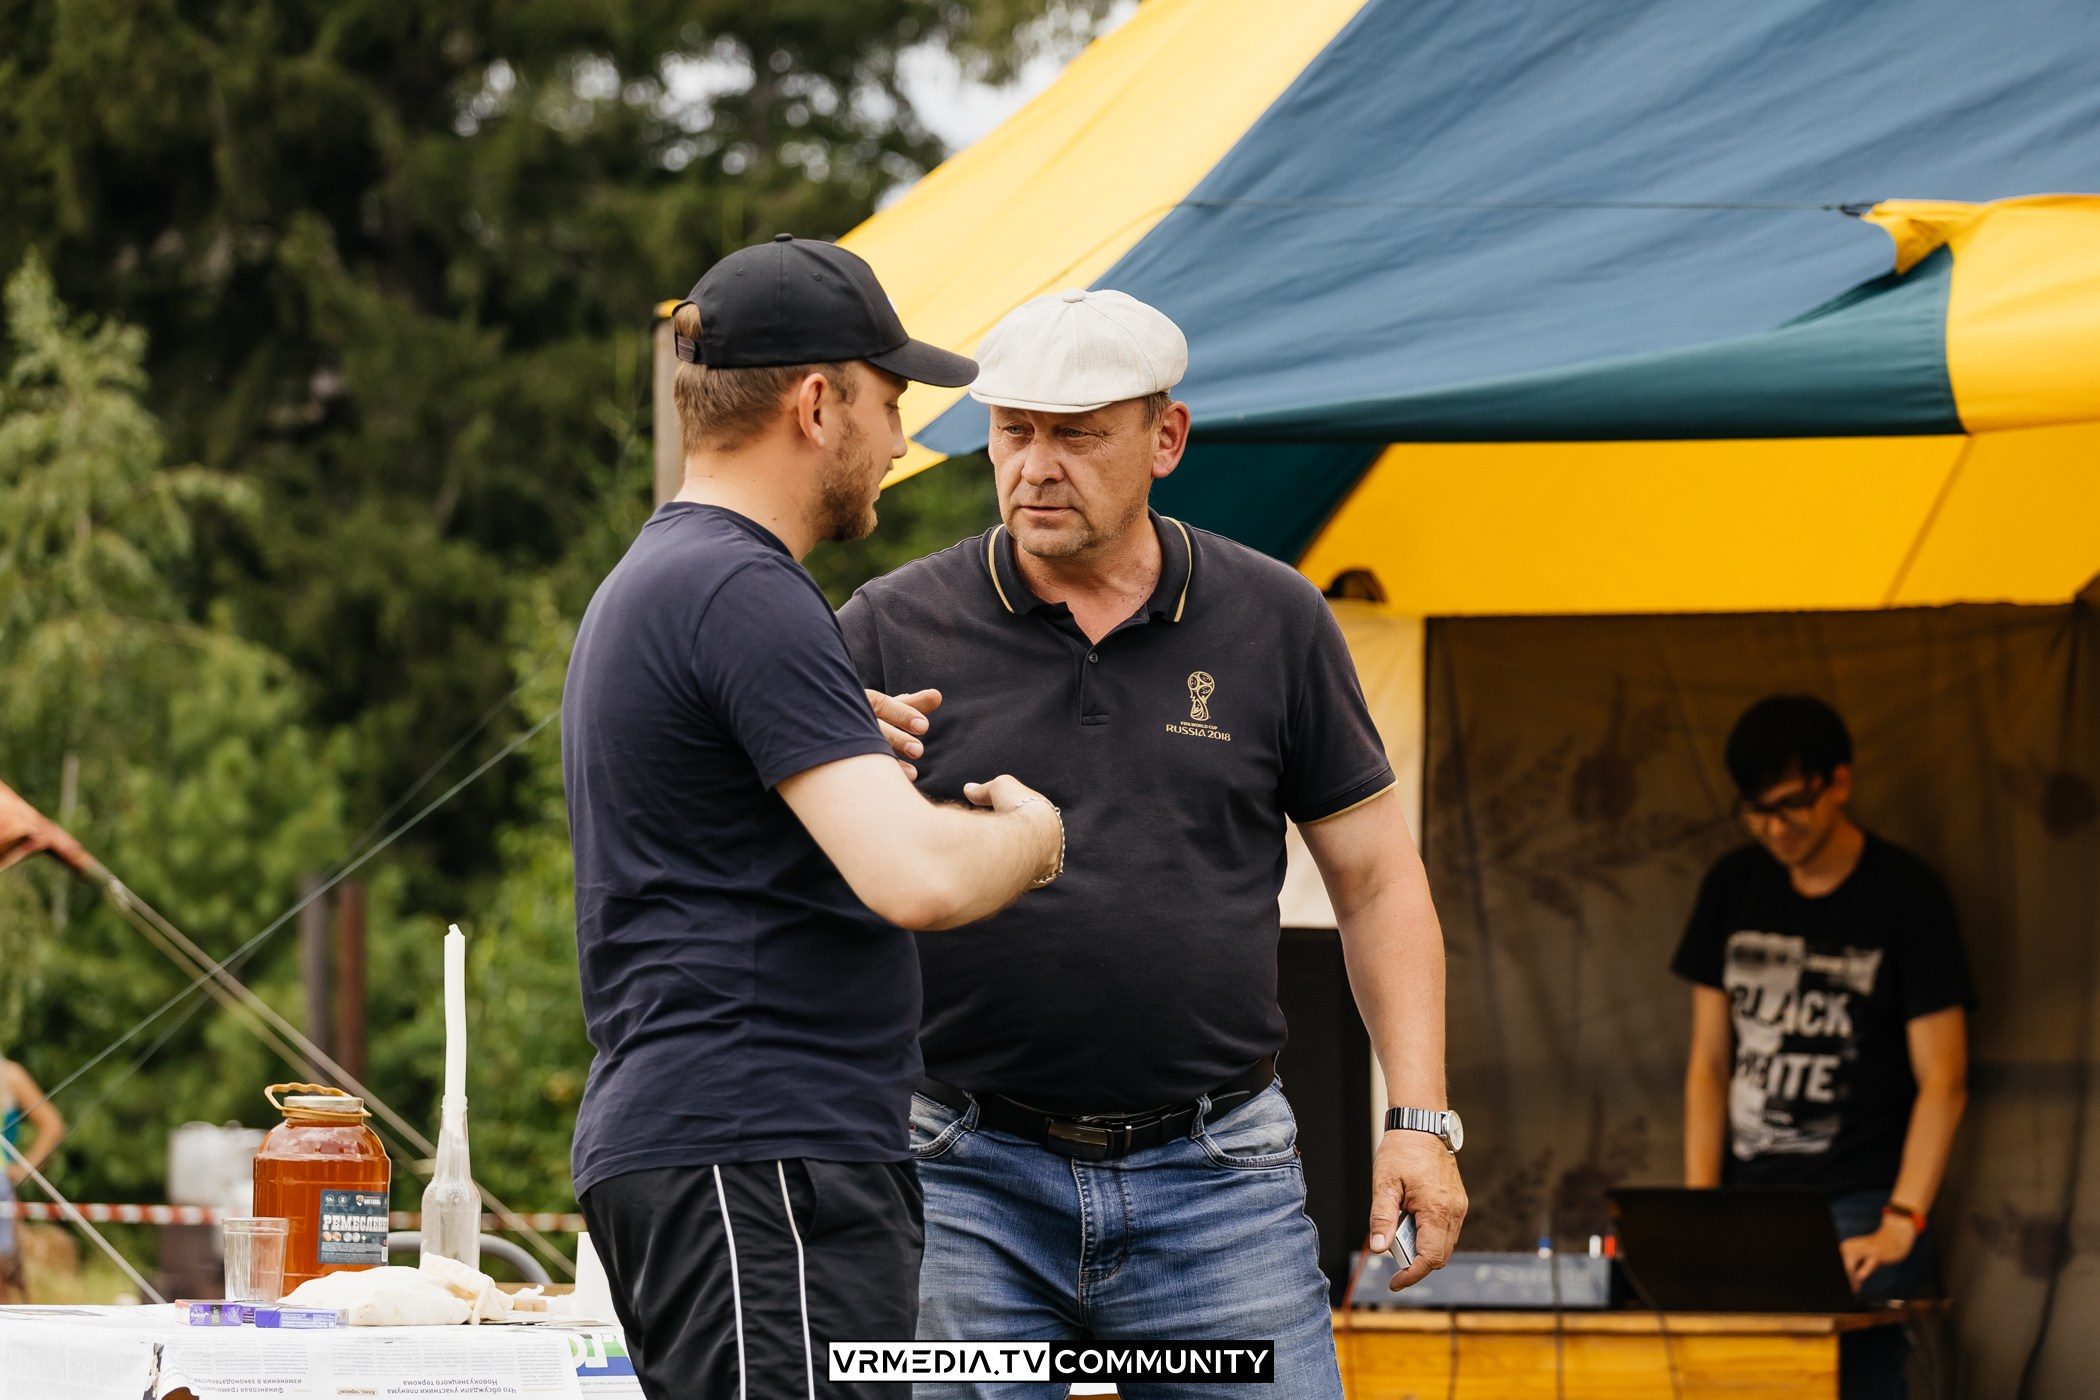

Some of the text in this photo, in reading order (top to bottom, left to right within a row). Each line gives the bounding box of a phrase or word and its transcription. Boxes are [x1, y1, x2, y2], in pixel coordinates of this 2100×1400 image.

[1166, 724, 1231, 742] RUSSIA 2018
[420, 1386, 459, 1394] участники
[460, 1386, 503, 1394] обсуждали
